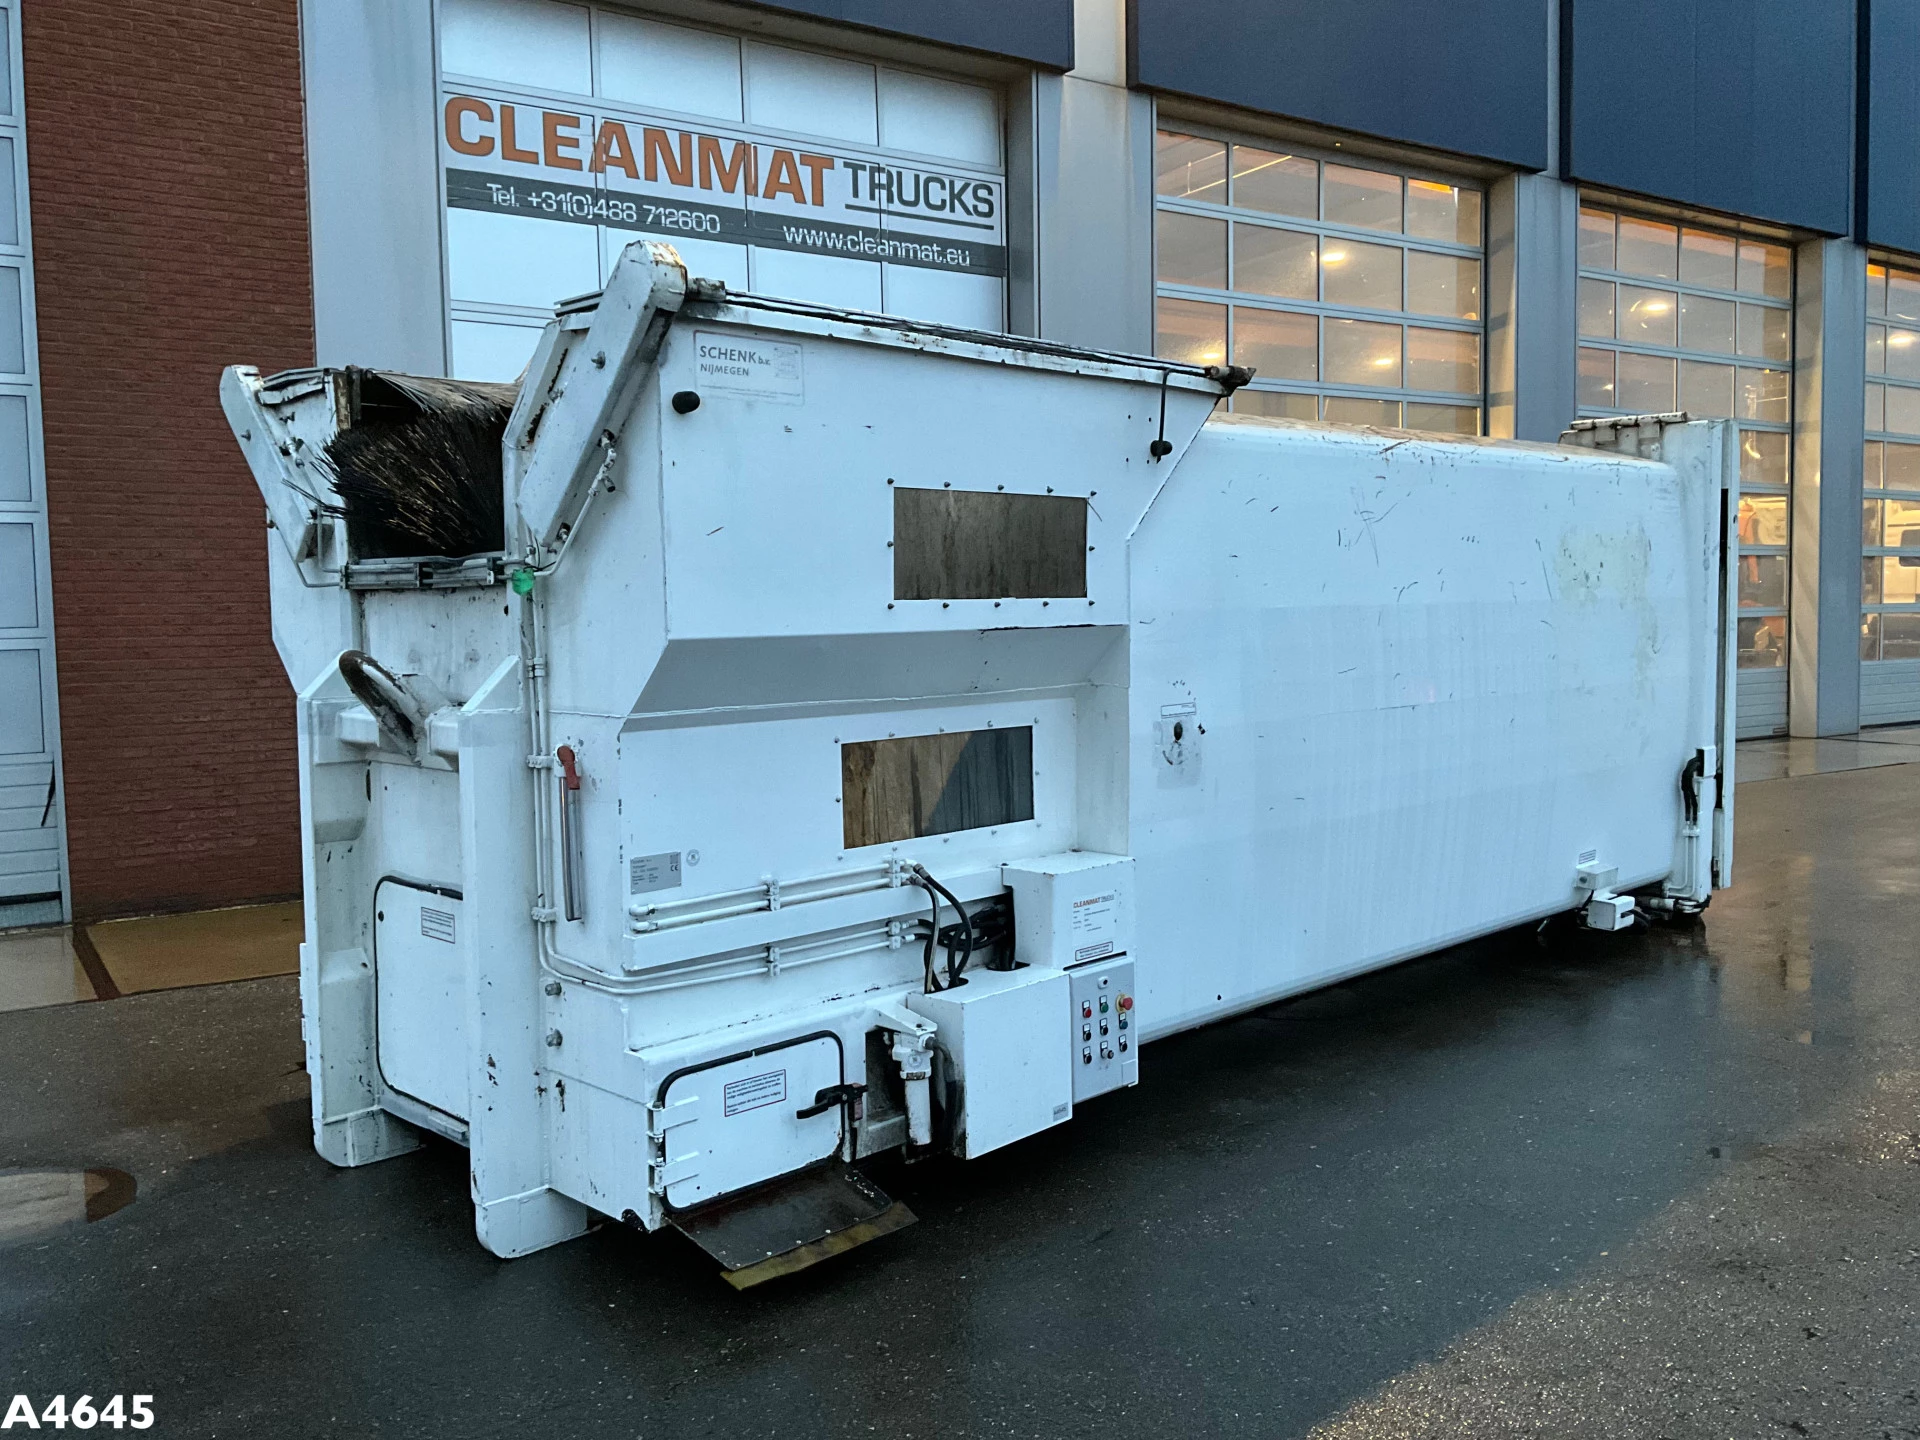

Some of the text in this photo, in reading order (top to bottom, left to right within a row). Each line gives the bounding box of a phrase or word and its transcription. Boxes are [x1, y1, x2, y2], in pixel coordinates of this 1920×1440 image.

[445, 96, 995, 219] CLEANMAT TRUCKS
[486, 182, 721, 234] Tel. +31(0)488 712600
[783, 225, 971, 267] www.cleanmat.eu
[700, 345, 757, 363] SCHENK
[700, 363, 750, 377] NIJMEGEN
